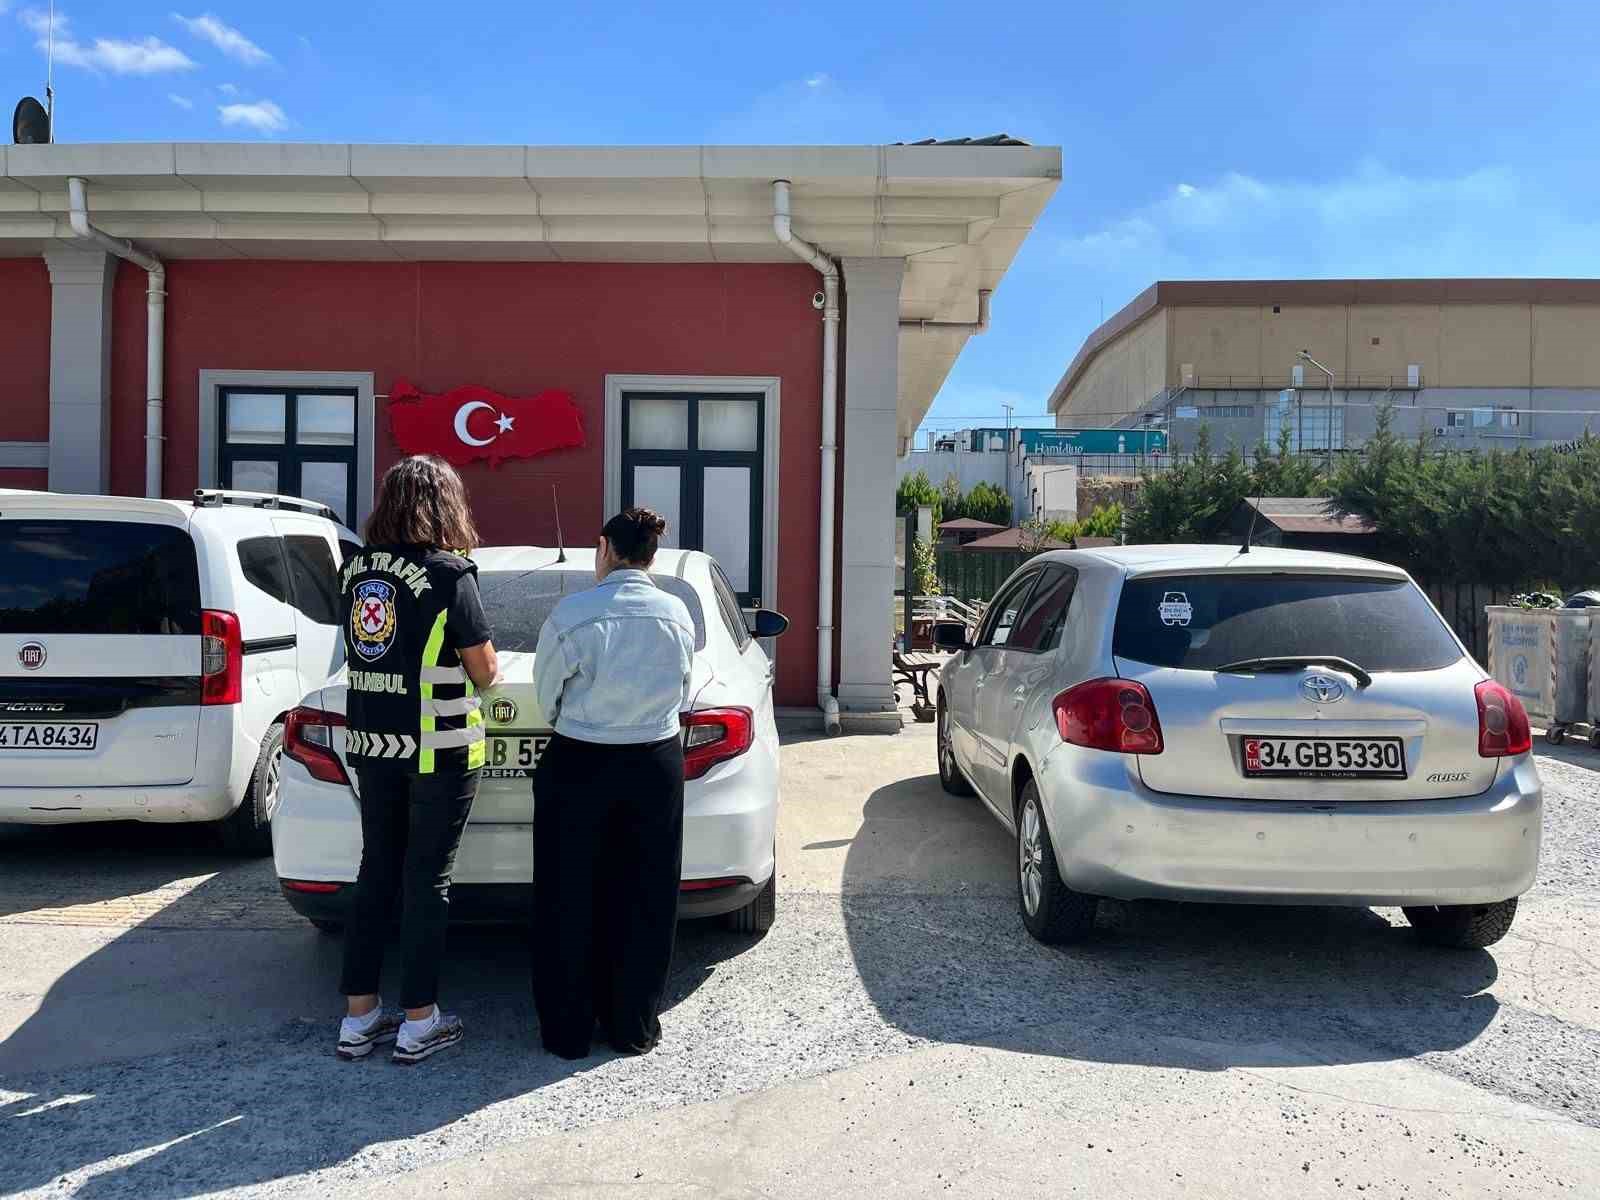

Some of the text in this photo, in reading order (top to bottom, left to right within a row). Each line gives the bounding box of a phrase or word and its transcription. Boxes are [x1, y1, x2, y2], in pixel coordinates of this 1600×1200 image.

[370, 551, 432, 598] TRAFİK
[24, 650, 41, 662] FIAT
[347, 667, 408, 695] TANBUL
[495, 706, 511, 719] FIAT
[484, 739, 507, 766] B
[480, 769, 528, 778] DEHA
